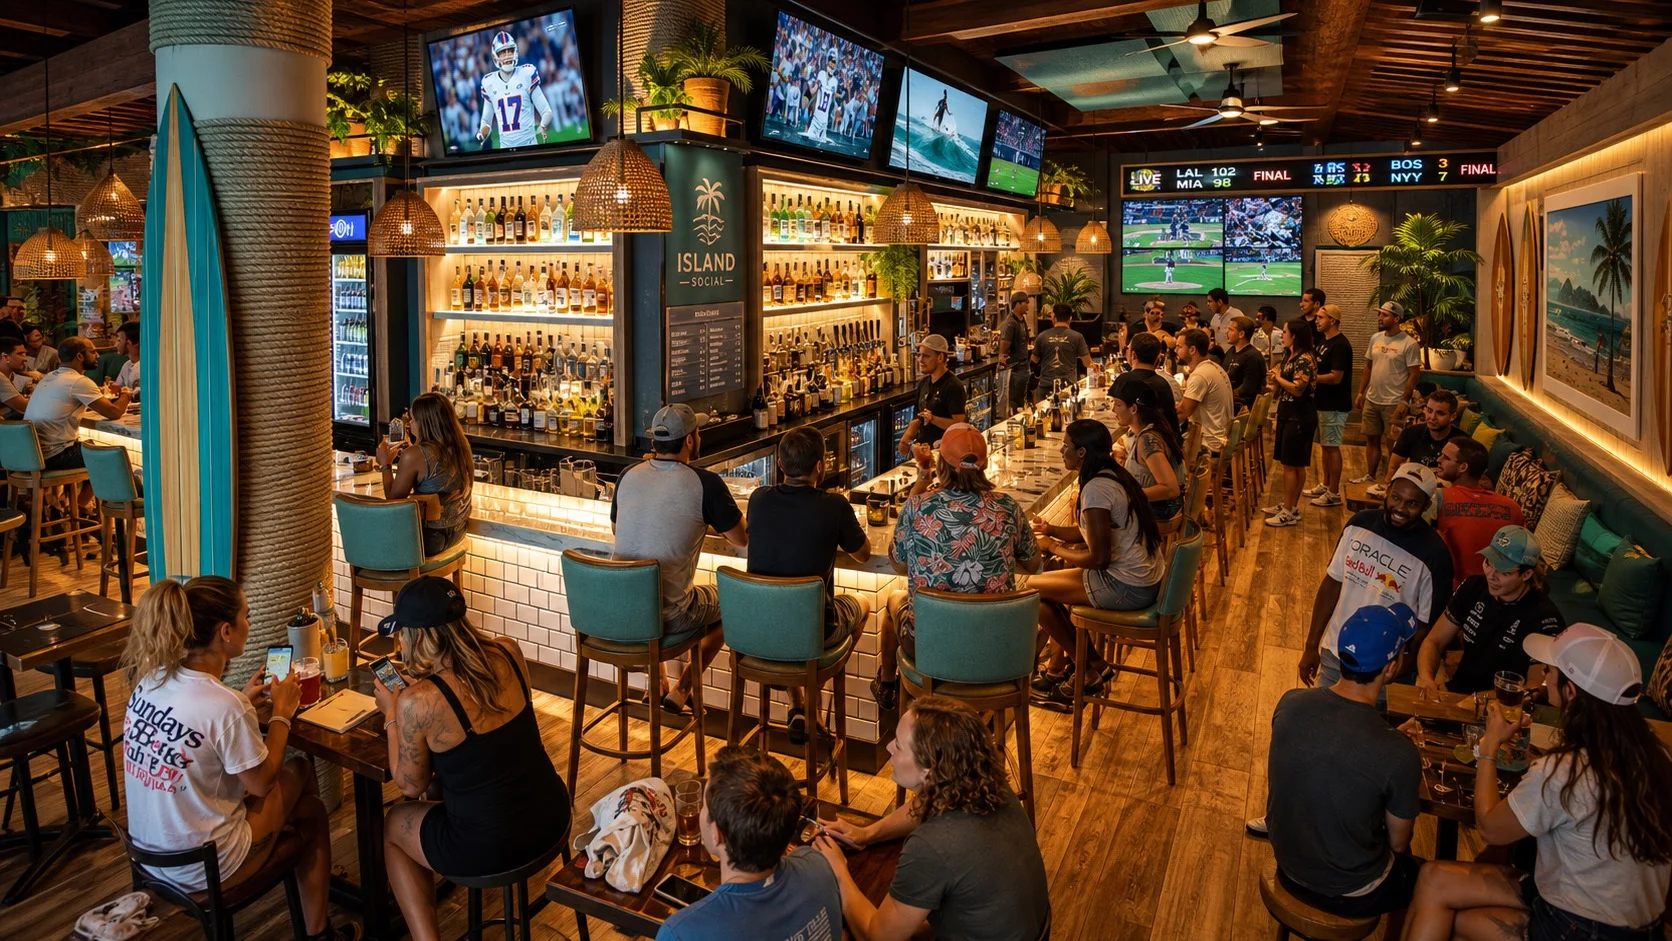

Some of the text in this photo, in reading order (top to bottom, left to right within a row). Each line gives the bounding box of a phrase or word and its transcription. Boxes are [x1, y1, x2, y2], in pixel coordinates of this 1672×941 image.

[497, 94, 522, 132] 17
[1391, 158, 1448, 170] BOS 3
[1460, 164, 1496, 175] FINAL
[1176, 167, 1236, 178] LAL 102
[1253, 170, 1292, 181] FINAL
[1391, 171, 1449, 183] NYY 7
[1130, 173, 1162, 186] LIVE
[1176, 178, 1232, 189] MIA 98
[677, 252, 736, 273] ISLAND
[691, 276, 724, 287] SOCIAL
[1350, 539, 1412, 580] ORACLE
